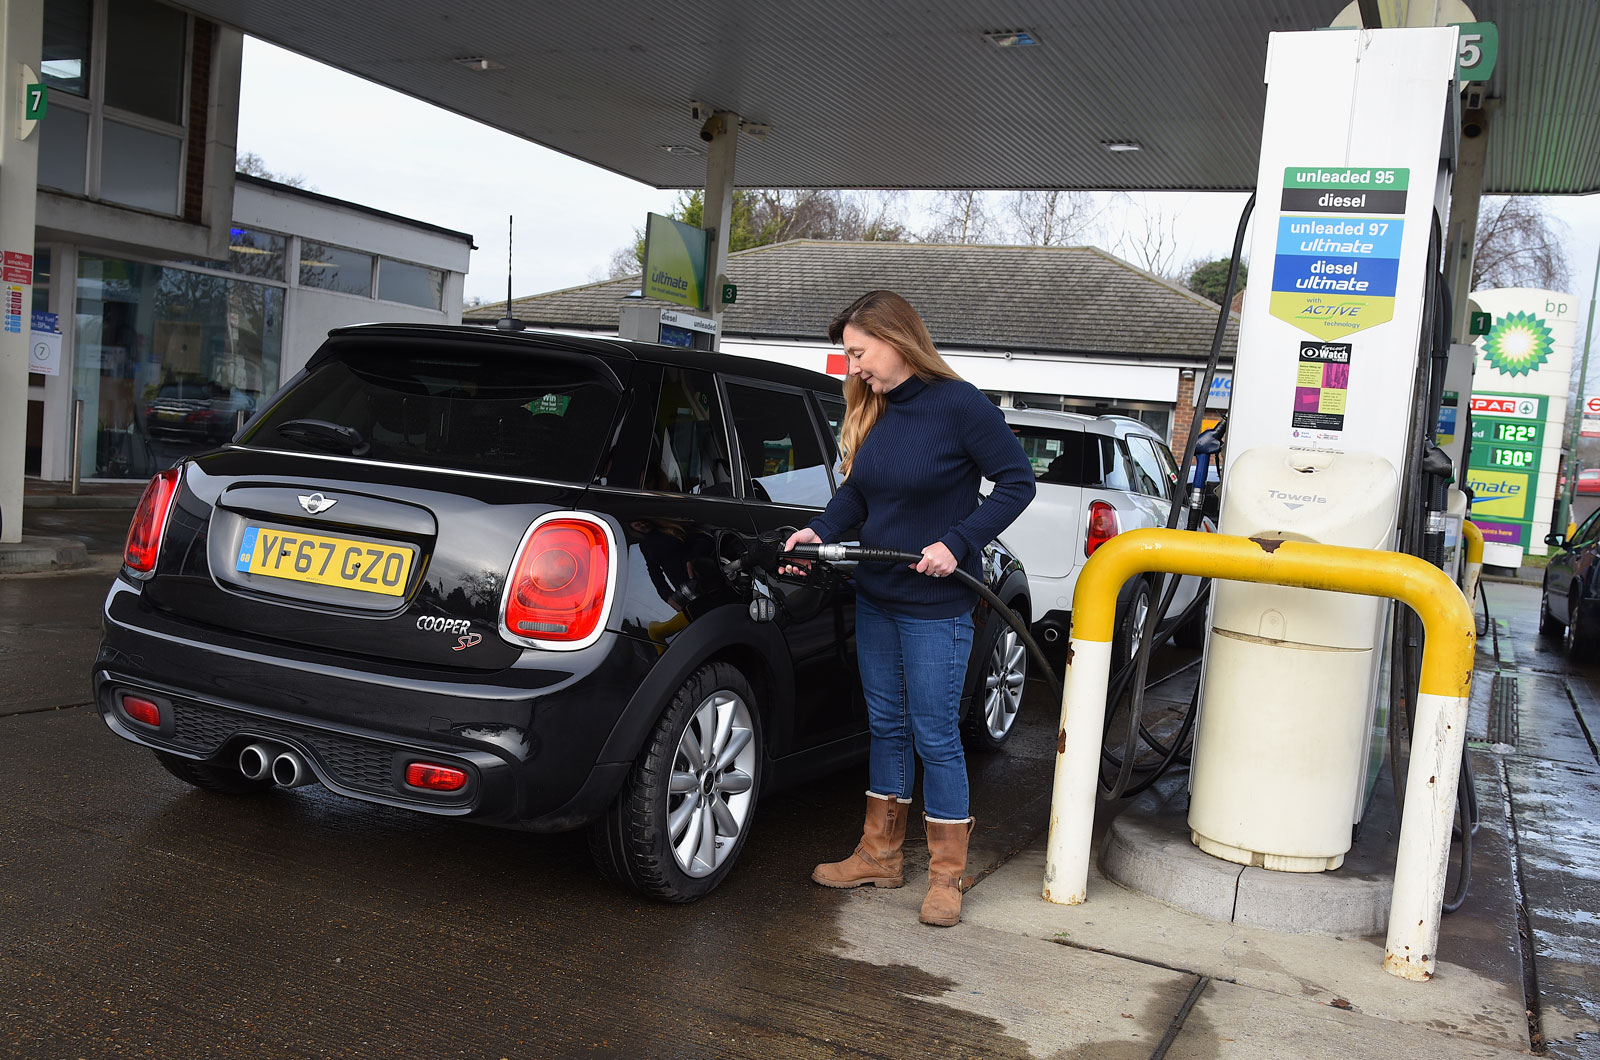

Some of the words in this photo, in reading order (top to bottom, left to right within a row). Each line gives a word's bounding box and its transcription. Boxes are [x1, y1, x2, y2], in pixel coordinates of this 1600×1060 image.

[1460, 34, 1481, 67] 5
[32, 91, 41, 111] 7
[1296, 169, 1370, 184] unleaded
[1374, 170, 1395, 184] 95
[1318, 193, 1366, 207] diesel
[1290, 221, 1365, 236] unleaded
[1368, 223, 1389, 236] 97
[1300, 238, 1374, 254] ultimate
[1310, 260, 1358, 275] diesel
[651, 271, 688, 291] ultimate
[1296, 275, 1369, 292] ultimate
[725, 288, 733, 299] 3
[1301, 305, 1361, 316] ACTIVE
[1545, 299, 1568, 317] bp
[661, 312, 678, 323] diesel
[693, 320, 717, 332] unleaded
[1324, 320, 1361, 329] technology
[1477, 316, 1484, 330] 1
[40, 346, 45, 356] 7
[1319, 349, 1348, 360] Watch
[542, 393, 557, 402] Win
[1267, 489, 1328, 504] Towels
[1499, 528, 1513, 536] here
[240, 552, 251, 563] GB
[261, 534, 337, 576] YF67
[340, 546, 405, 587] GZO
[416, 615, 472, 635] COOPER
[451, 632, 483, 651] SD
